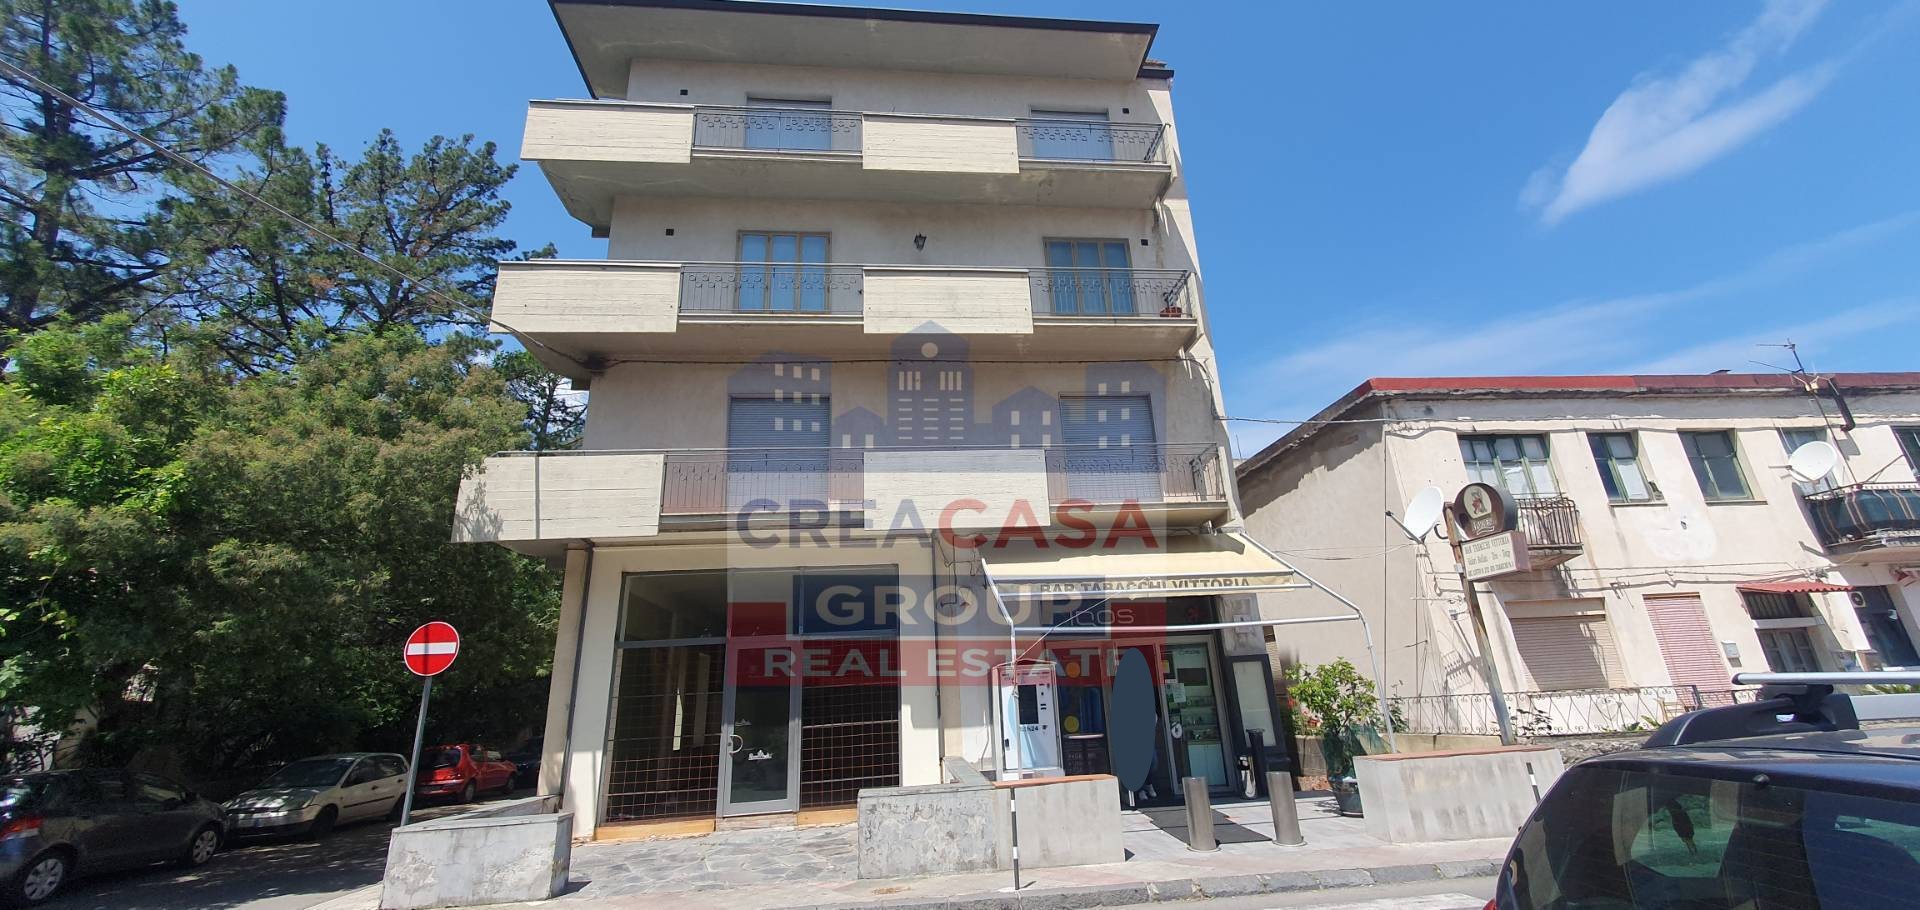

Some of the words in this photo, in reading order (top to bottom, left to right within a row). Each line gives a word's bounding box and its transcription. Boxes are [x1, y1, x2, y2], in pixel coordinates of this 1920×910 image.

[1040, 583, 1075, 593] BAR
[1081, 579, 1166, 592] TABACCHI
[1170, 578, 1250, 589] VITTORIA
[1070, 608, 1135, 627] IQOS
